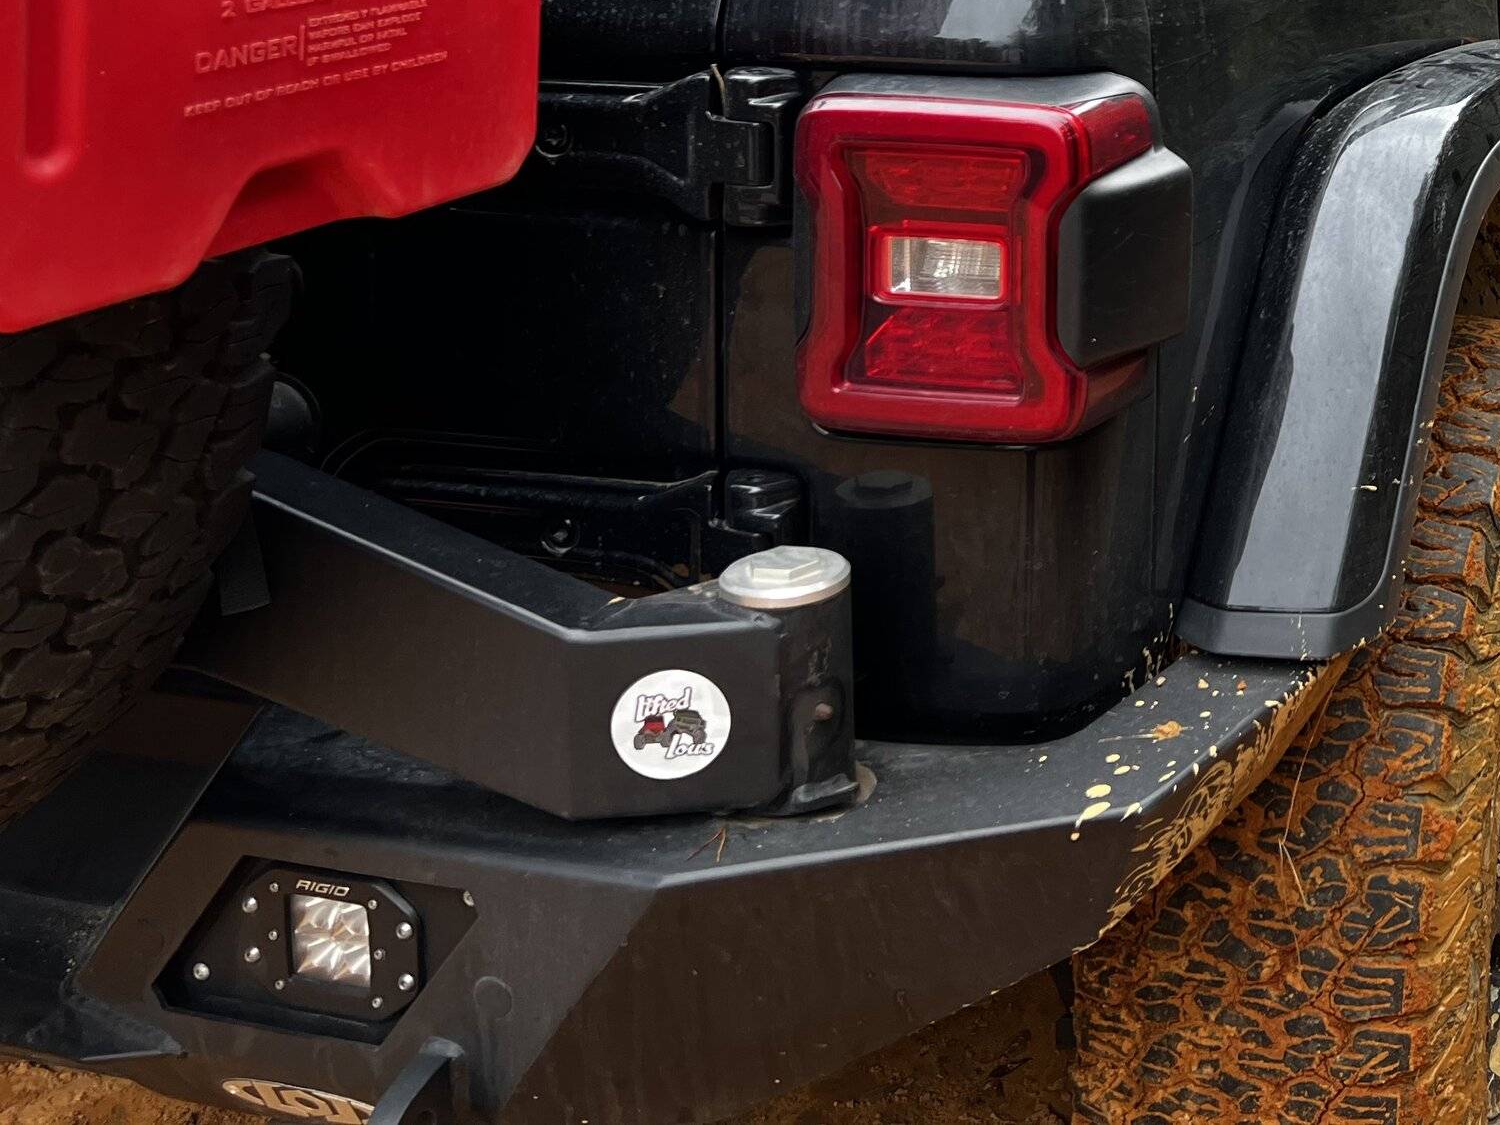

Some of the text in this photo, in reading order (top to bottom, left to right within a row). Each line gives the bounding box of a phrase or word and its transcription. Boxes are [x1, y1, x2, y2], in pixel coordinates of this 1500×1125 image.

[220, 0, 237, 20] 2
[193, 35, 299, 74] DANGER
[295, 879, 350, 897] RIGID
